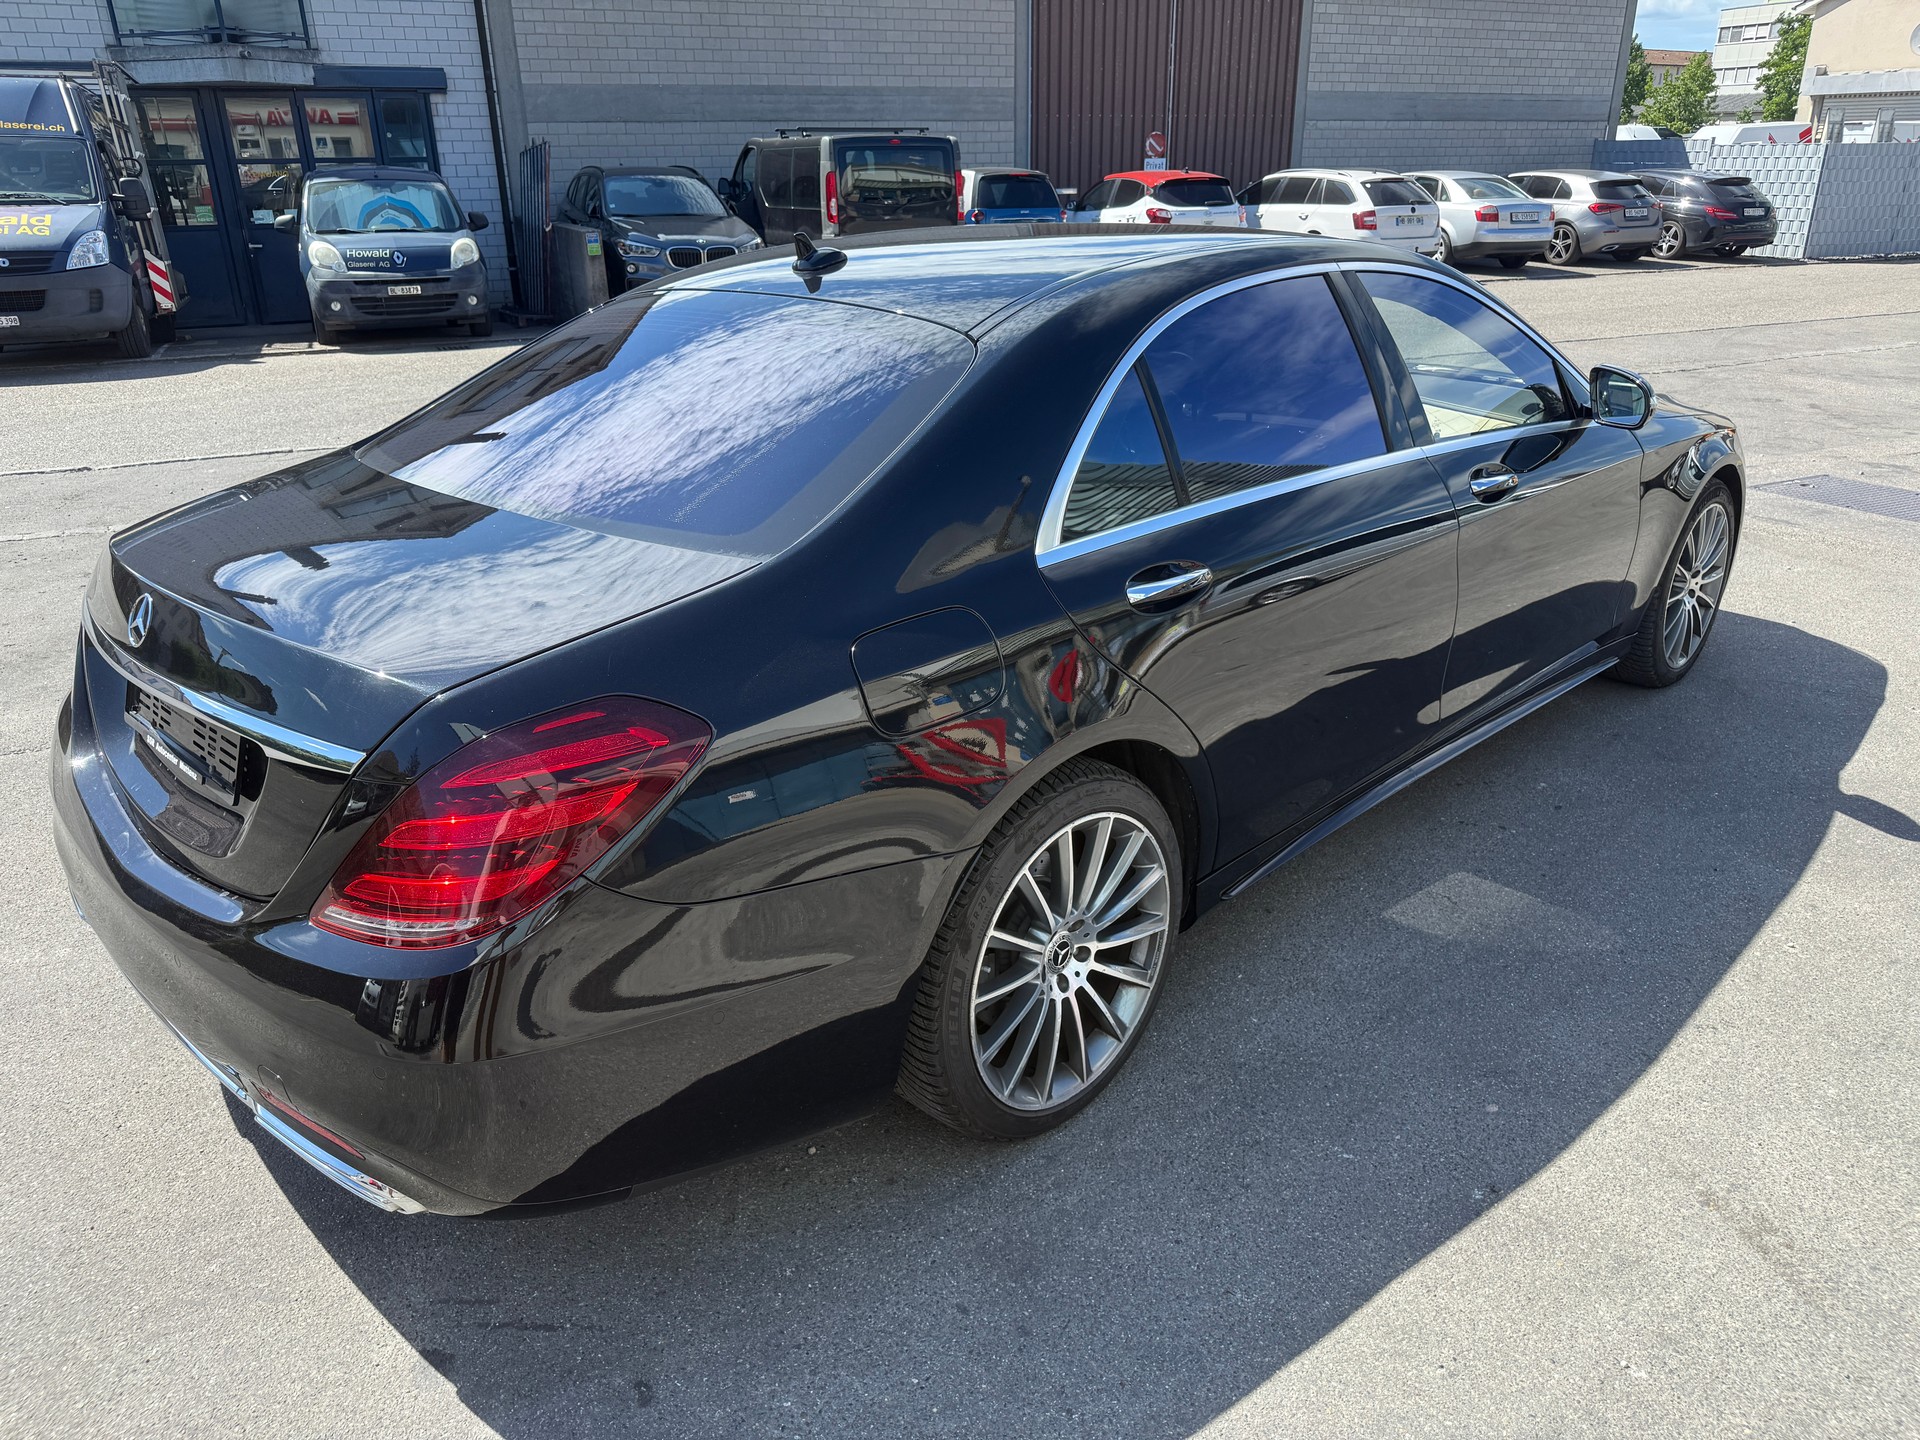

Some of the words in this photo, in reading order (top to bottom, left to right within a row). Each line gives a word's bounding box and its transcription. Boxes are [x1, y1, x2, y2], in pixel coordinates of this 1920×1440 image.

[1146, 161, 1164, 170] Privat
[15, 225, 50, 236] AG
[346, 248, 390, 258] Howald
